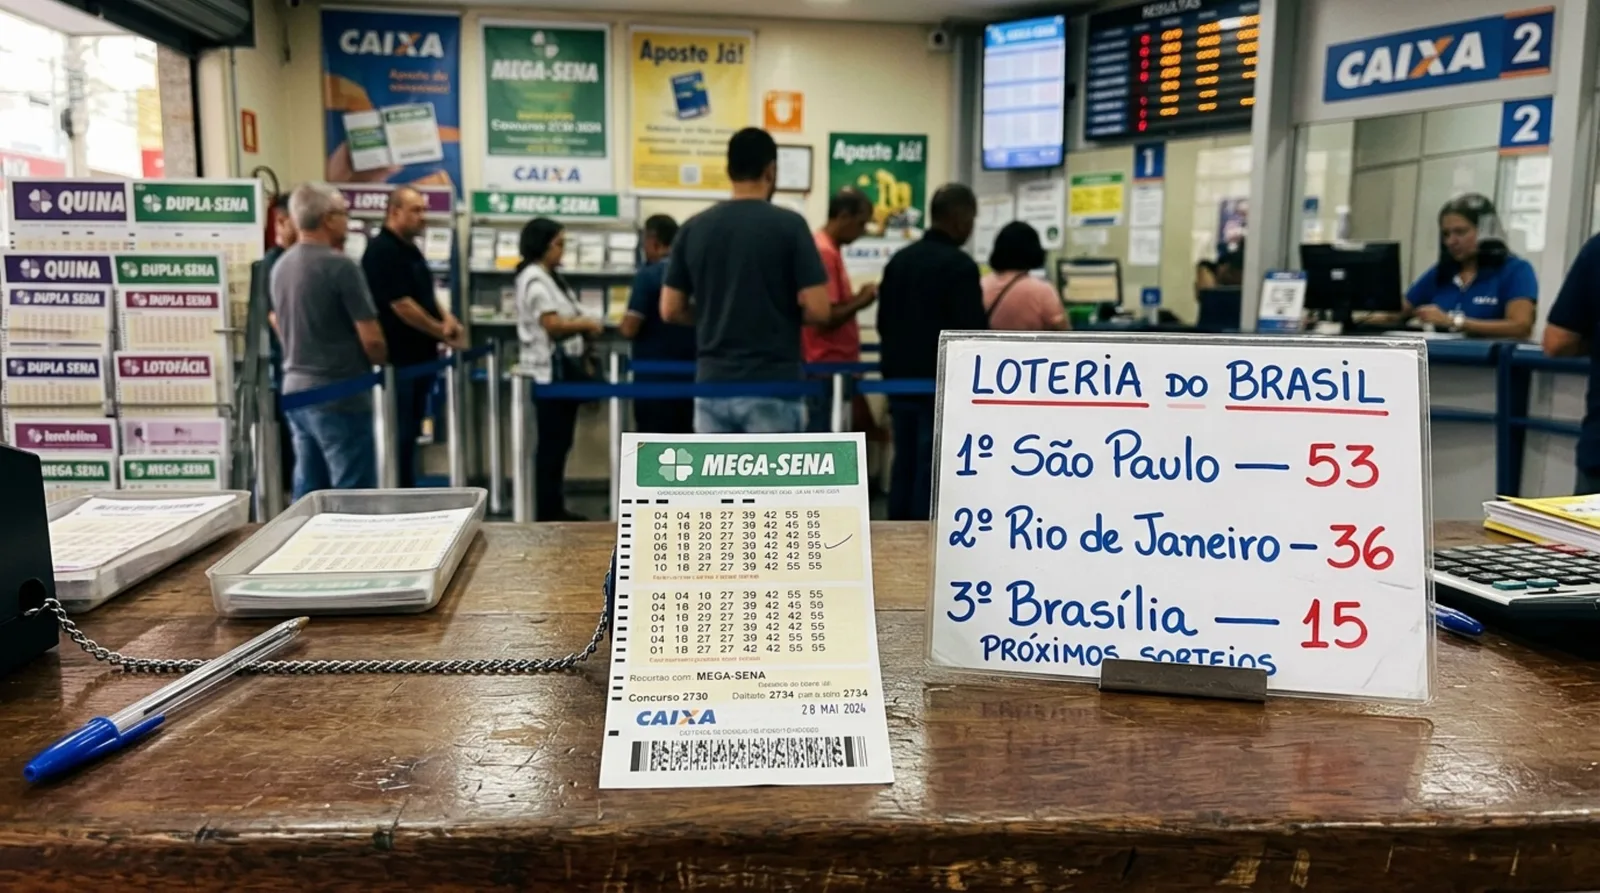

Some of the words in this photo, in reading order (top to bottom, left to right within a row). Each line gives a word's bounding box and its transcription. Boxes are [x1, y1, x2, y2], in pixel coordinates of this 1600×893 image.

[339, 28, 444, 58] CAIXA
[1512, 23, 1542, 64] 2
[639, 39, 708, 66] Aposte
[715, 41, 745, 65] Já!
[1336, 31, 1485, 89] CAIXA
[491, 60, 598, 83] MEGA-SENA
[1511, 104, 1542, 142] 2
[1142, 149, 1155, 175] 1
[513, 166, 580, 183] CAIXA
[57, 190, 125, 213] QUINA
[44, 260, 101, 279] QUINA
[1165, 373, 1208, 398] DO
[700, 452, 836, 477] MEGA-SENA
[1011, 433, 1094, 478] São
[1105, 428, 1220, 483] Paulo
[1305, 442, 1381, 488] 53
[654, 511, 668, 520] 04
[676, 511, 691, 520] 04
[699, 511, 713, 520] 18
[720, 510, 734, 520] 27
[742, 510, 756, 520] 39
[763, 510, 777, 519] 42
[784, 510, 799, 519] 55
[653, 521, 668, 531] 04
[698, 521, 713, 530] 20
[720, 521, 734, 530] 27
[763, 520, 778, 530] 42
[698, 531, 712, 541] 20
[720, 531, 734, 541] 27
[763, 530, 779, 540] 42
[785, 530, 800, 540] 42
[807, 530, 821, 539] 55
[1006, 504, 1066, 552] Rio
[1079, 512, 1123, 554] de
[1133, 511, 1280, 563] Janeiro
[1327, 524, 1395, 571] 36
[653, 542, 668, 552] 06
[677, 542, 690, 552] 18
[698, 542, 712, 551] 20
[720, 541, 735, 551] 27
[763, 540, 779, 550] 42
[653, 552, 667, 562] 04
[677, 552, 690, 562] 18
[720, 551, 735, 561] 29
[764, 551, 779, 560] 42
[786, 551, 800, 560] 42
[654, 563, 668, 572] 10
[676, 562, 690, 572] 18
[697, 562, 712, 572] 27
[720, 562, 734, 572] 27
[742, 561, 757, 572] 39
[764, 561, 779, 571] 42
[786, 561, 801, 571] 55
[808, 561, 824, 571] 55
[651, 592, 666, 601] 04
[674, 591, 689, 601] 04
[719, 590, 734, 600] 27
[742, 590, 757, 600] 39
[764, 590, 779, 599] 42
[787, 589, 802, 599] 55
[809, 589, 824, 599] 55
[651, 602, 666, 612] 04
[675, 602, 690, 611] 18
[697, 601, 712, 611] 20
[719, 601, 734, 611] 27
[742, 601, 758, 611] 39
[764, 601, 780, 610] 42
[1006, 579, 1198, 636] Brasília
[1300, 597, 1369, 650] 15
[650, 613, 666, 623] 04
[720, 612, 734, 622] 27
[765, 611, 780, 621] 42
[787, 611, 802, 621] 42
[810, 611, 825, 620] 55
[650, 624, 665, 633] 01
[697, 623, 712, 633] 27
[719, 623, 734, 632] 27
[742, 622, 758, 632] 39
[765, 622, 780, 631] 42
[788, 622, 803, 631] 42
[810, 622, 825, 631] 55
[650, 635, 665, 644] 04
[696, 634, 711, 644] 27
[720, 633, 735, 643] 27
[743, 633, 758, 643] 39
[765, 632, 780, 642] 42
[788, 632, 803, 642] 55
[810, 632, 826, 642] 55
[649, 645, 664, 655] 01
[675, 645, 689, 654] 18
[696, 644, 711, 654] 27
[719, 644, 735, 654] 27
[742, 644, 758, 653] 42
[765, 643, 781, 653] 42
[696, 671, 766, 681] MEGA-SENA
[628, 693, 680, 703] Concurso
[682, 692, 708, 702] 2730
[769, 690, 795, 700] 2734
[843, 688, 869, 698] 2734
[636, 709, 717, 726] CAIXA
[801, 704, 817, 716] 28
[820, 704, 840, 715] MAI
[843, 702, 867, 715] 2024
